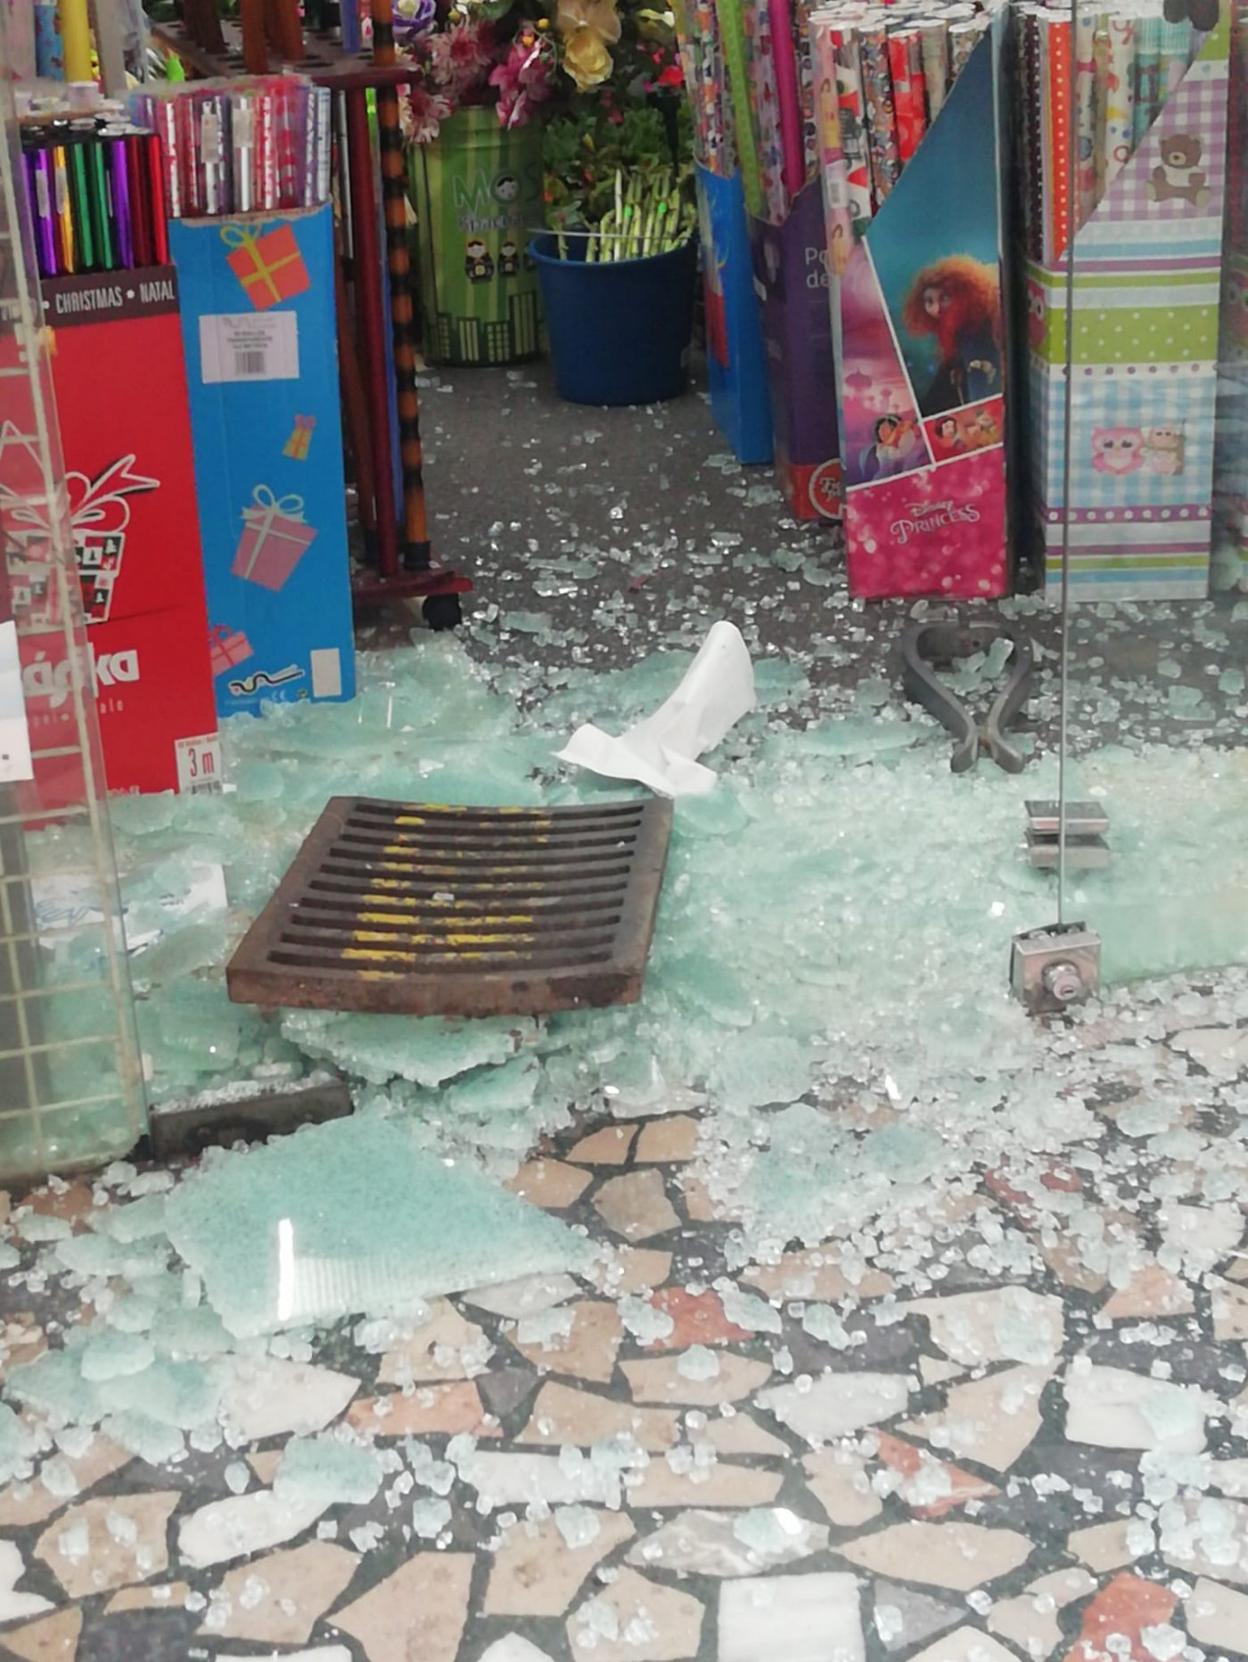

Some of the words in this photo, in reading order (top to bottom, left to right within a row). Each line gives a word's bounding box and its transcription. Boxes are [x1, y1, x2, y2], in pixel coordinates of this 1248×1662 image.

[55, 285, 123, 314] CHRISTMAS
[139, 280, 175, 303] NATAL
[188, 748, 198, 777] 3
[202, 752, 215, 774] m
